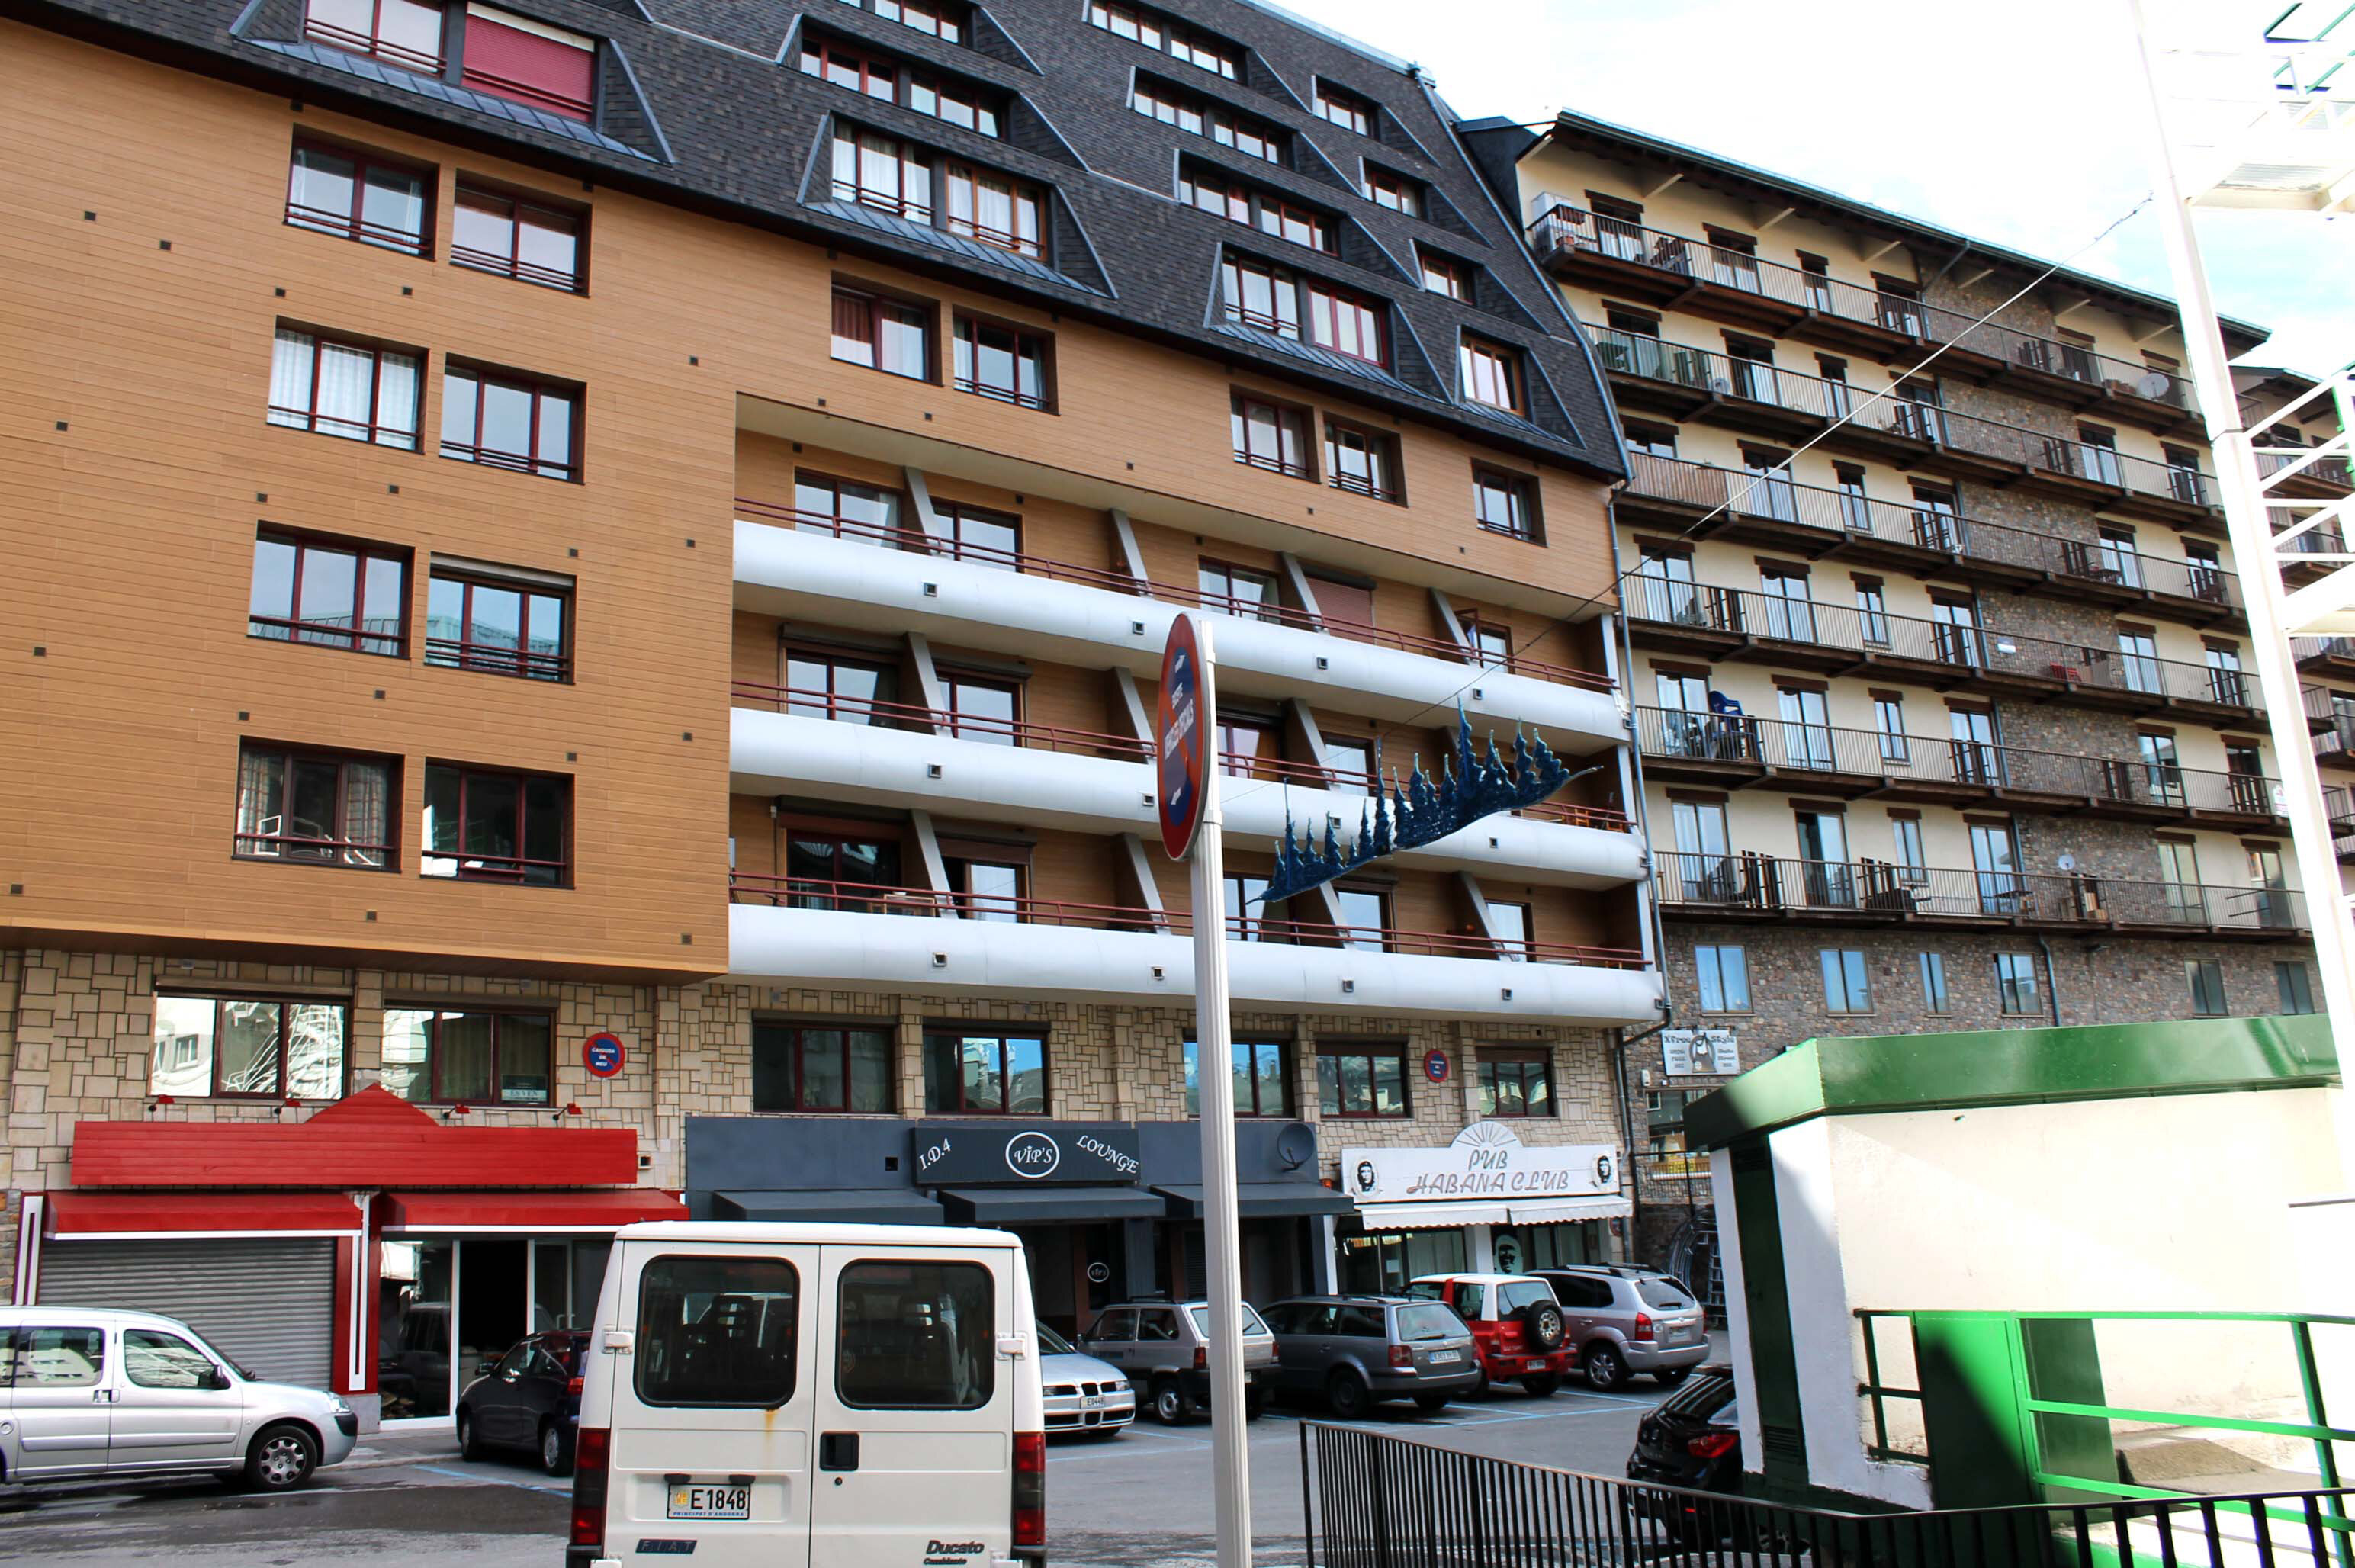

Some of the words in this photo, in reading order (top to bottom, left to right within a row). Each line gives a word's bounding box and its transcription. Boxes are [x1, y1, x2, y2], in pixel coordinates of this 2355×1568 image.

[919, 1137, 952, 1171] I.D.4
[1076, 1135, 1139, 1174] LOUNGE
[1467, 1149, 1508, 1171] PUB
[1406, 1172, 1505, 1194] HABANA
[1510, 1170, 1569, 1191] CLUB
[690, 1489, 746, 1510] E1848
[641, 1541, 693, 1551] FIAT
[926, 1539, 985, 1554] Ducato
